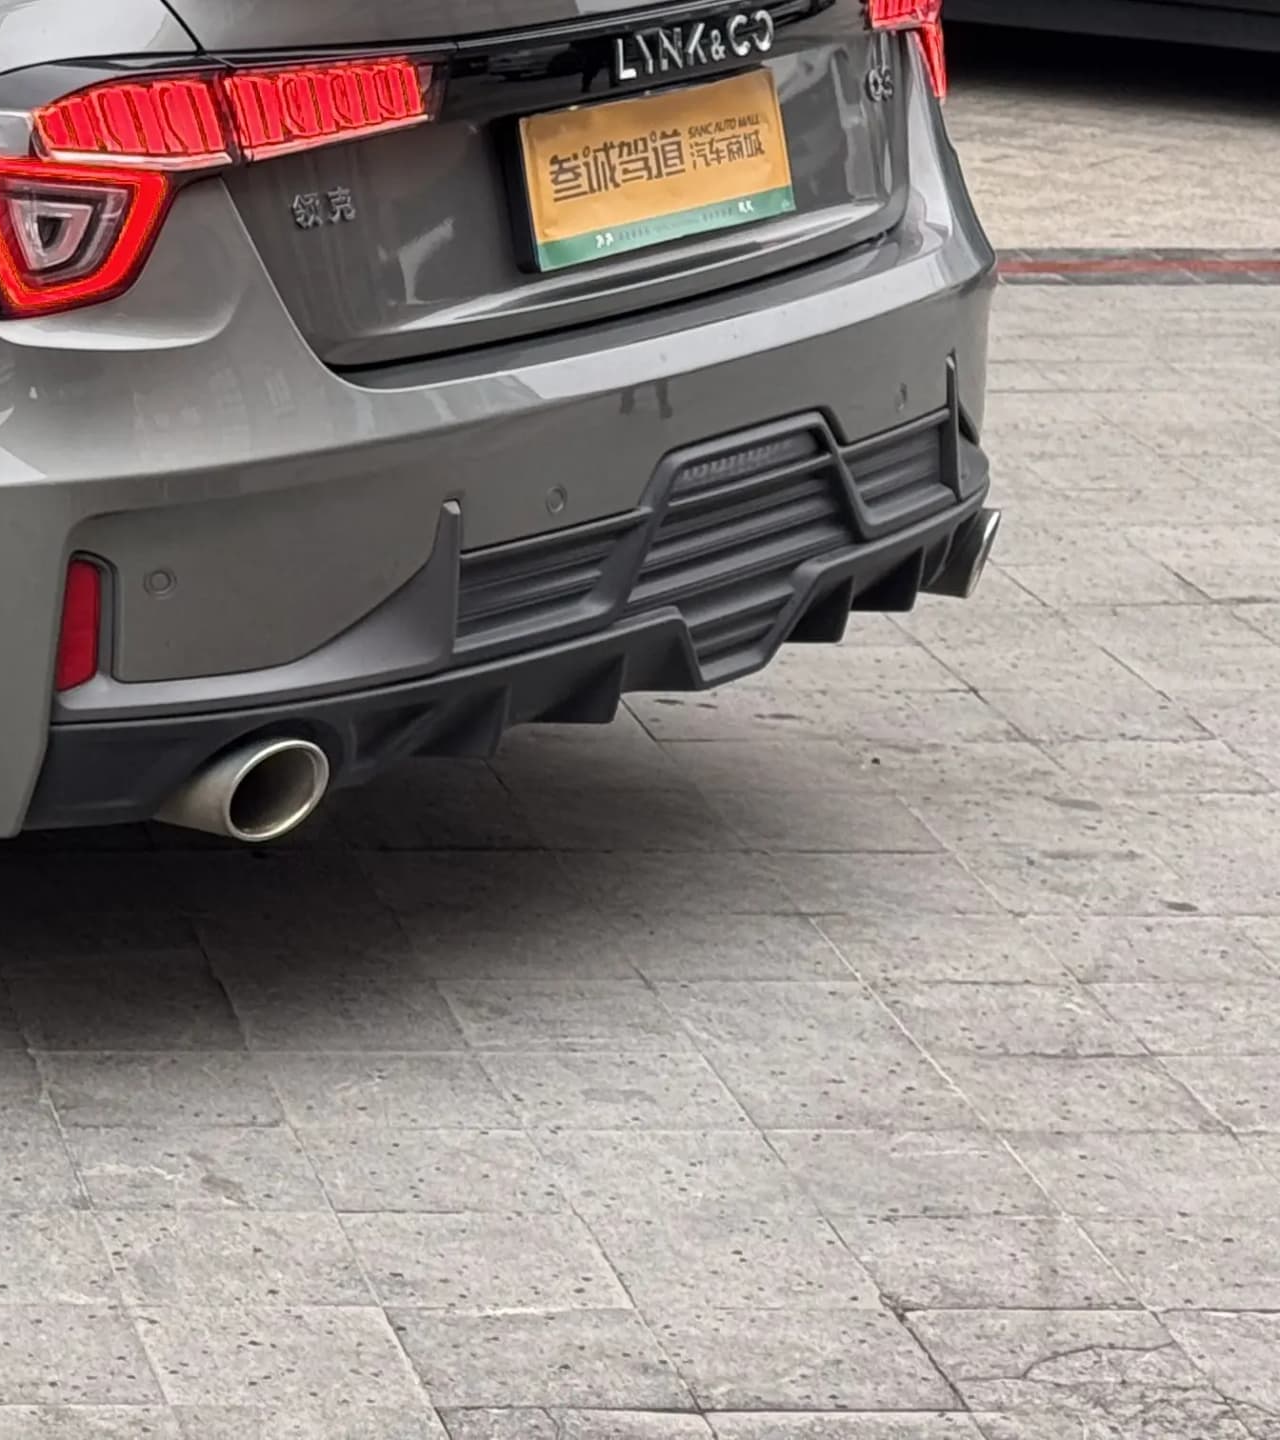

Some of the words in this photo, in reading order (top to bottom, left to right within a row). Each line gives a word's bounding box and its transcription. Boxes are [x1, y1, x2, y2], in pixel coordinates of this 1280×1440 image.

[615, 9, 775, 81] LYNK&CO
[687, 121, 713, 139] SANC
[713, 118, 737, 135] AUTO
[737, 112, 761, 130] MALL
[549, 129, 687, 204] 叁诚驾道
[689, 128, 766, 172] 汽车商城
[291, 185, 357, 228] 领克
